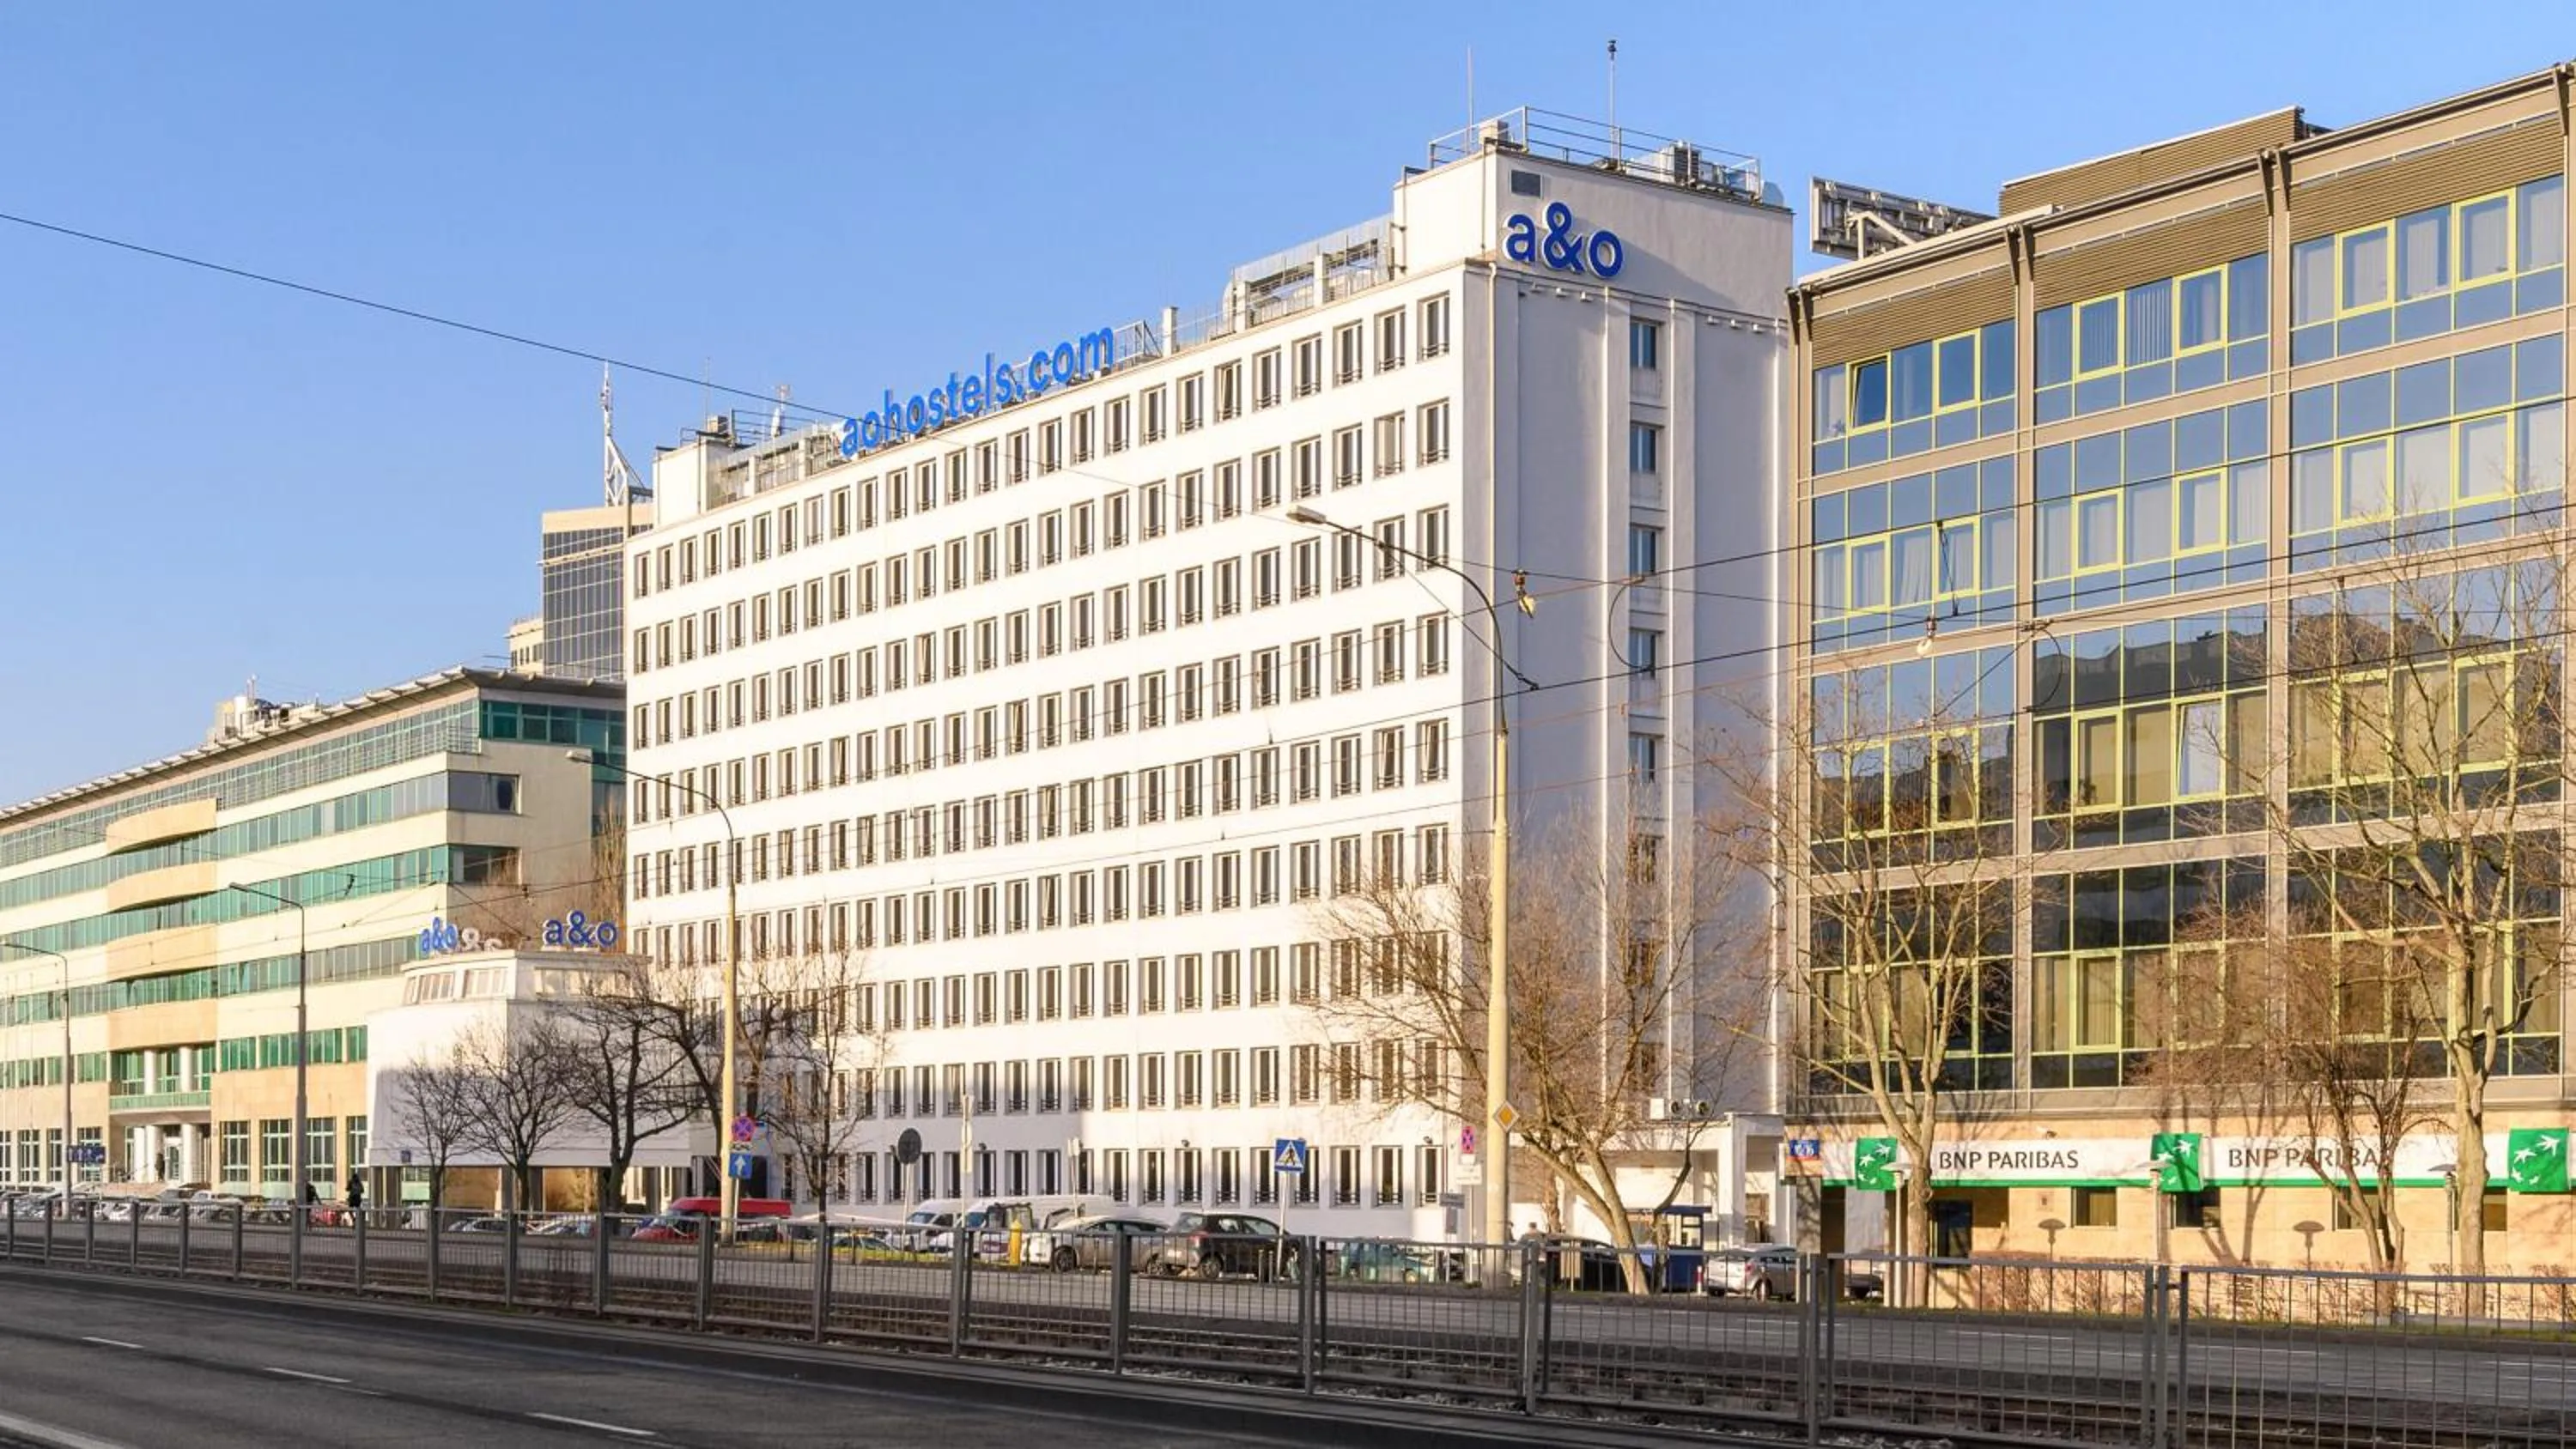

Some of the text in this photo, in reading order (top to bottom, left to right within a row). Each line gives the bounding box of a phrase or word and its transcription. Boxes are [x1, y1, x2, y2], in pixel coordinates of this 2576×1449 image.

[1504, 200, 1624, 278] a&o
[841, 327, 1114, 457] aohostels.com
[421, 916, 458, 953] a&o
[544, 910, 617, 948] a&o
[1939, 1150, 2079, 1169] BNP PARIBAS
[2228, 1148, 2392, 1168] BNP PARIBA
